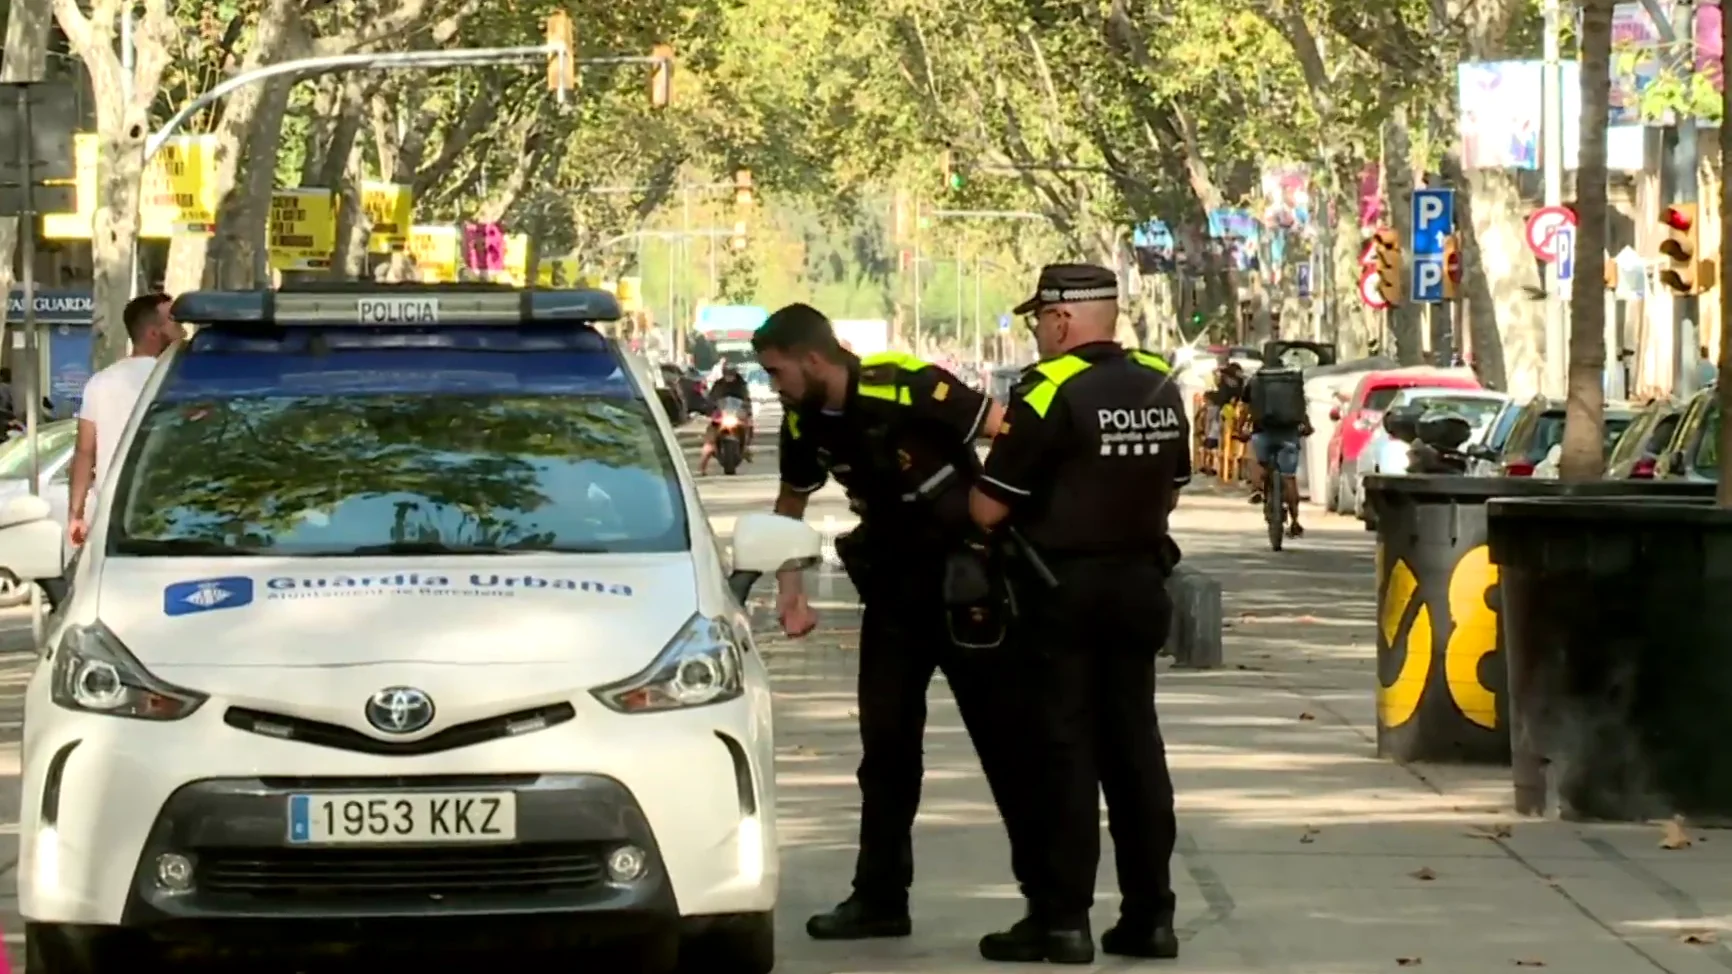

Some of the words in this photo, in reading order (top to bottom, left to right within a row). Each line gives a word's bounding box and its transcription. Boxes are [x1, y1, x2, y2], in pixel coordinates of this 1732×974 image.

[1419, 196, 1443, 230] P
[1419, 263, 1442, 297] P
[361, 302, 434, 322] POLICIA
[1097, 407, 1180, 430] POLICIA
[469, 573, 633, 597] Urbana
[322, 800, 414, 836] 1953
[430, 798, 501, 835] KKZ
